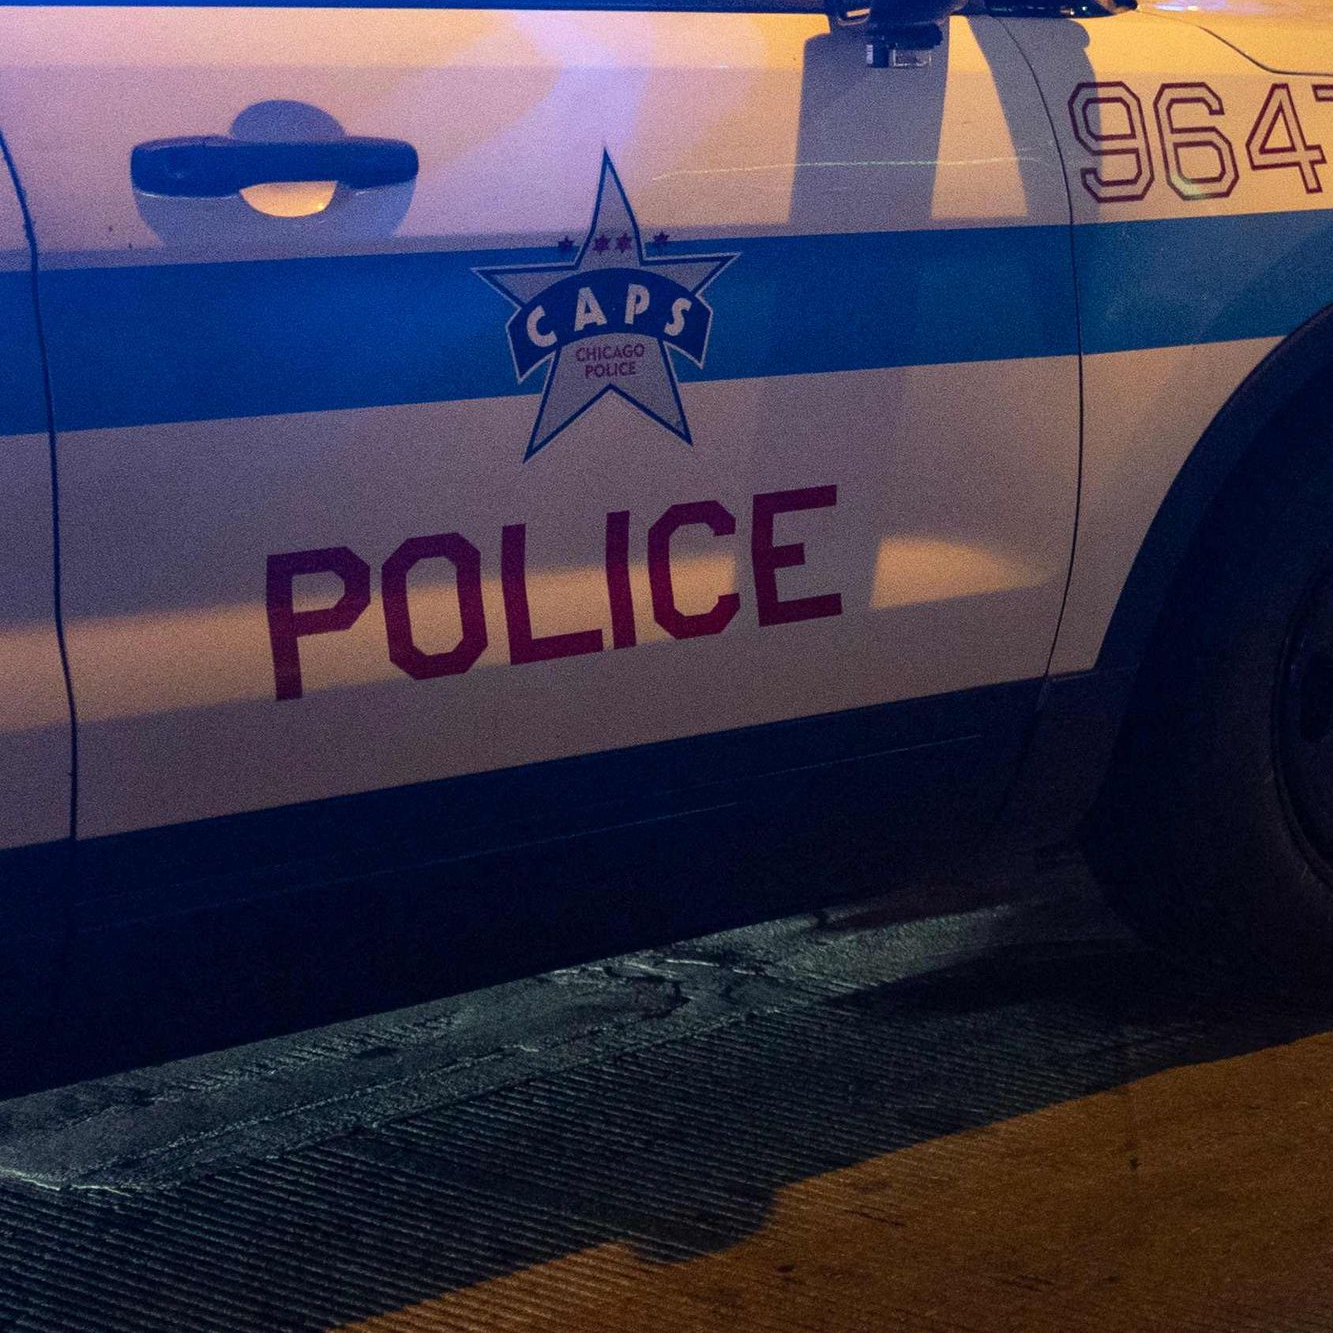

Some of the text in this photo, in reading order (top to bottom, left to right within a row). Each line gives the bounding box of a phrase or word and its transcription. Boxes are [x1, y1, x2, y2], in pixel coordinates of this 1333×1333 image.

[526, 283, 693, 348] CAPS
[575, 343, 645, 363] CHICAGO
[585, 361, 637, 379] POLICE
[266, 484, 843, 701] POLICE
